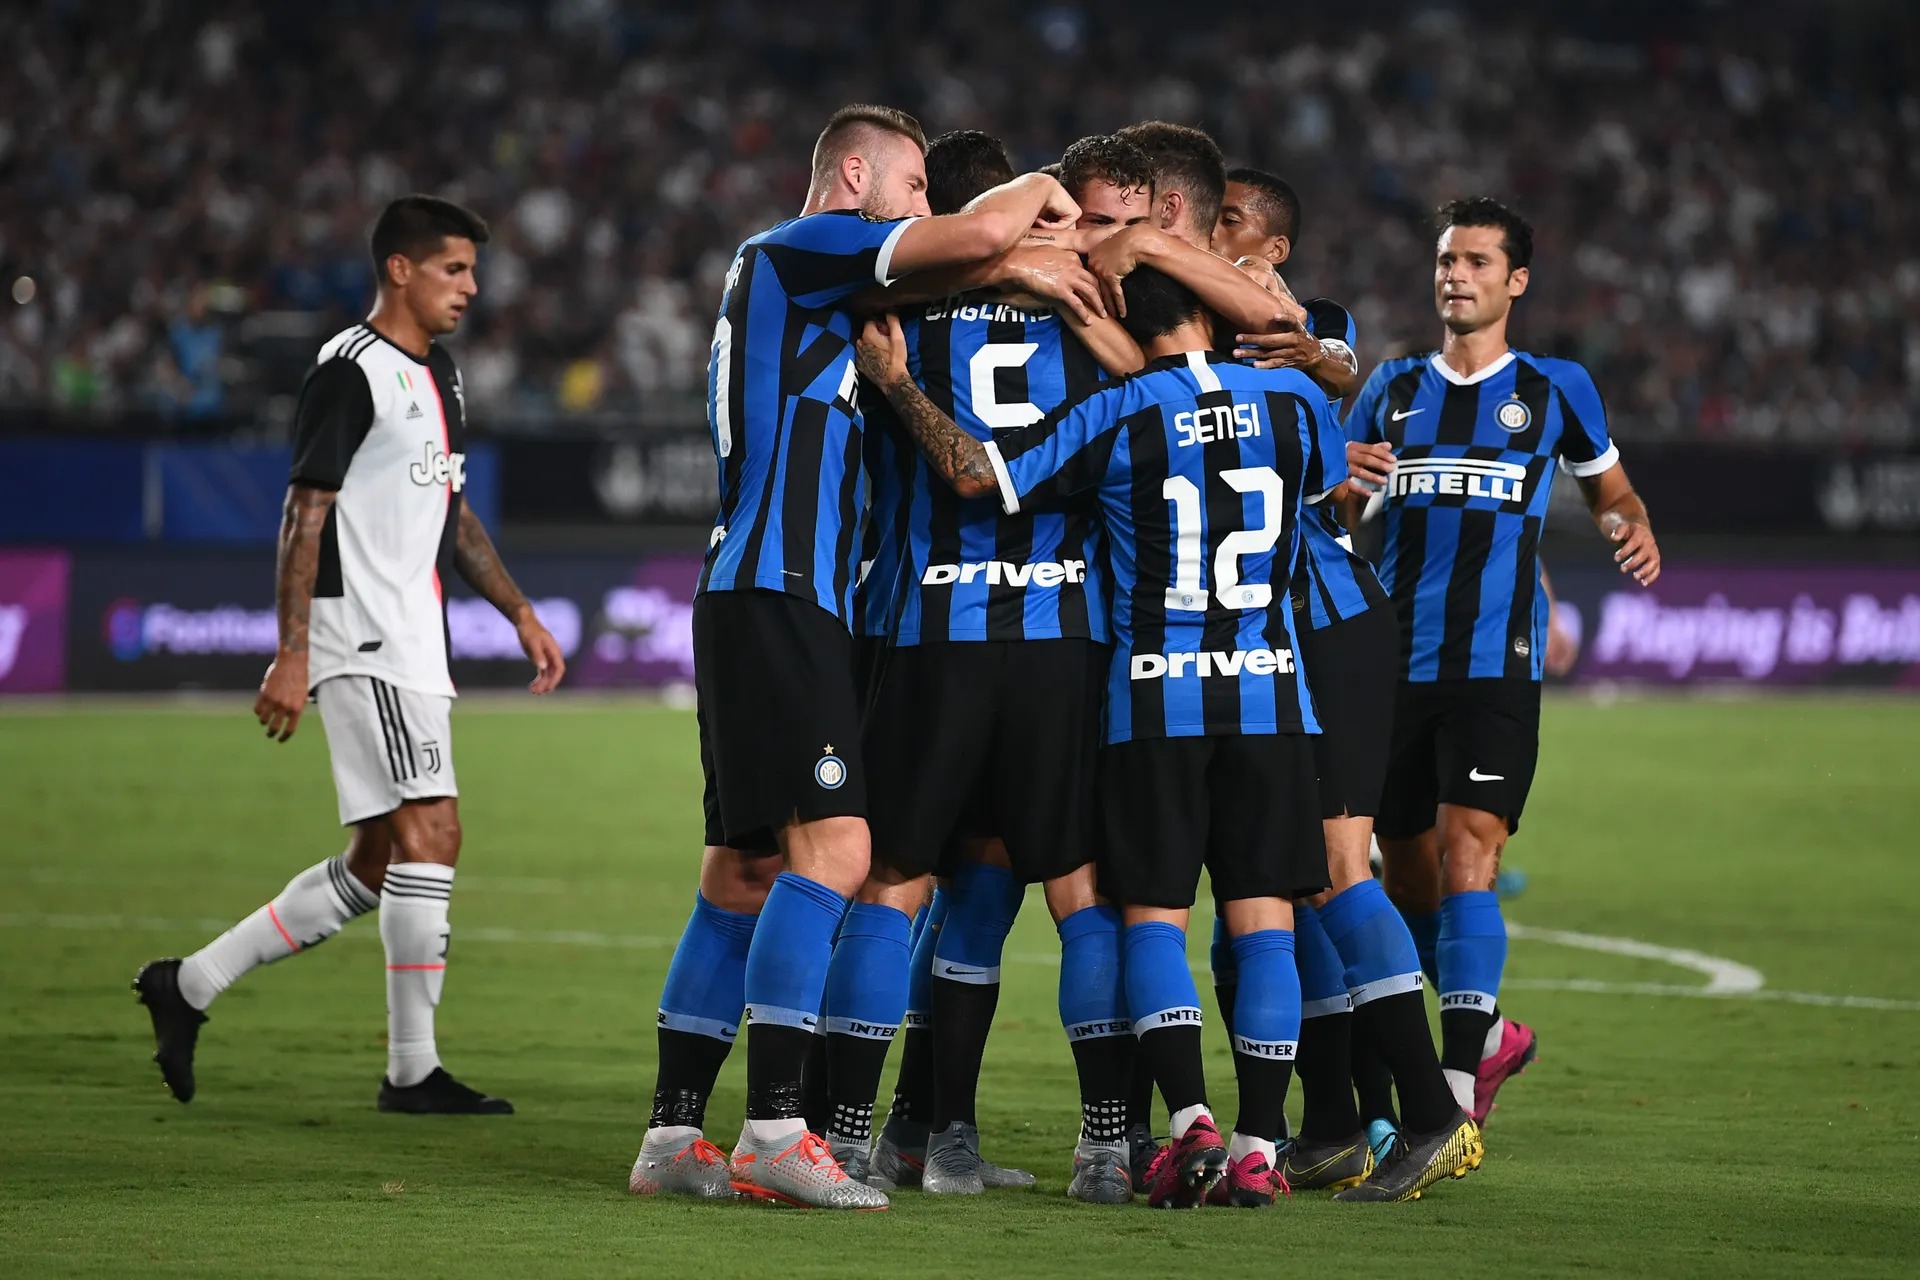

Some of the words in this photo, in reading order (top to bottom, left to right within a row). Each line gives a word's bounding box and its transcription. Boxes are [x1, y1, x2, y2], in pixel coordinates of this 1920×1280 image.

[1174, 403, 1261, 447] SENSI
[1163, 466, 1284, 611] 12
[849, 1021, 899, 1038] INTER
[1073, 1020, 1132, 1038] INTER
[1241, 1039, 1293, 1056] INTER
